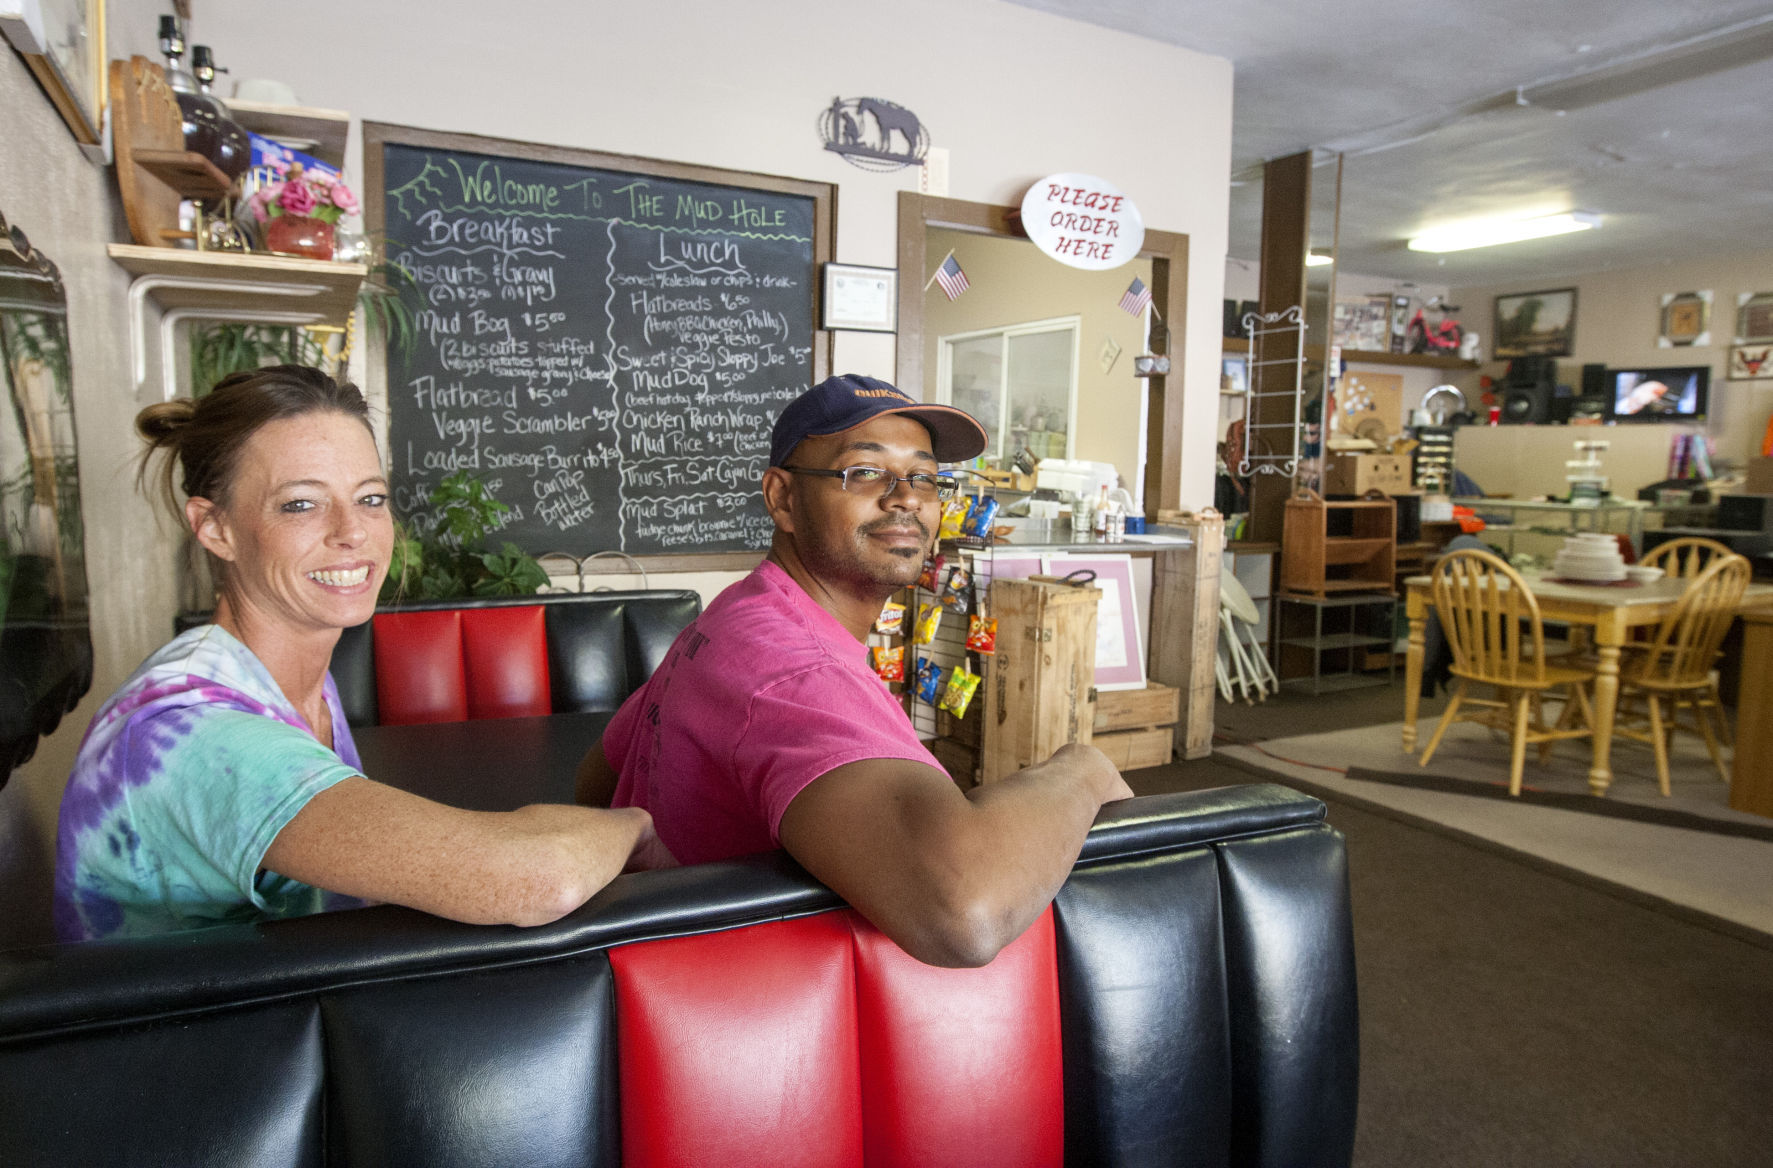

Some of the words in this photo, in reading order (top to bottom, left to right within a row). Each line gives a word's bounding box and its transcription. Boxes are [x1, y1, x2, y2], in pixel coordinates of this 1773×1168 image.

[448, 158, 560, 209] Welcome
[564, 178, 602, 210] To
[612, 182, 664, 218] THE
[1047, 184, 1124, 212] PLEASE
[416, 209, 561, 248] Breakfast
[1051, 211, 1119, 238] ORDER
[660, 232, 746, 268] Lunch
[1056, 237, 1114, 260] HERE
[631, 290, 712, 315] Flatbreads
[415, 309, 461, 346] Mud
[720, 329, 760, 345] Pesto
[718, 346, 758, 372] Sloppy
[760, 343, 785, 366] Joe
[408, 375, 517, 409] Flatbread
[633, 370, 672, 391] Mud
[672, 369, 708, 394] Dog
[432, 411, 495, 448] Veggie
[503, 411, 591, 434] Scrambler
[623, 409, 685, 431] Chicken
[685, 407, 729, 431] Ranch
[728, 405, 762, 430] Wrap
[632, 432, 665, 456] Mud
[667, 430, 703, 456] Rice
[408, 441, 479, 476] Loaded
[484, 446, 544, 477] Sausage
[626, 502, 657, 522] Mud
[663, 500, 708, 520] Splat
